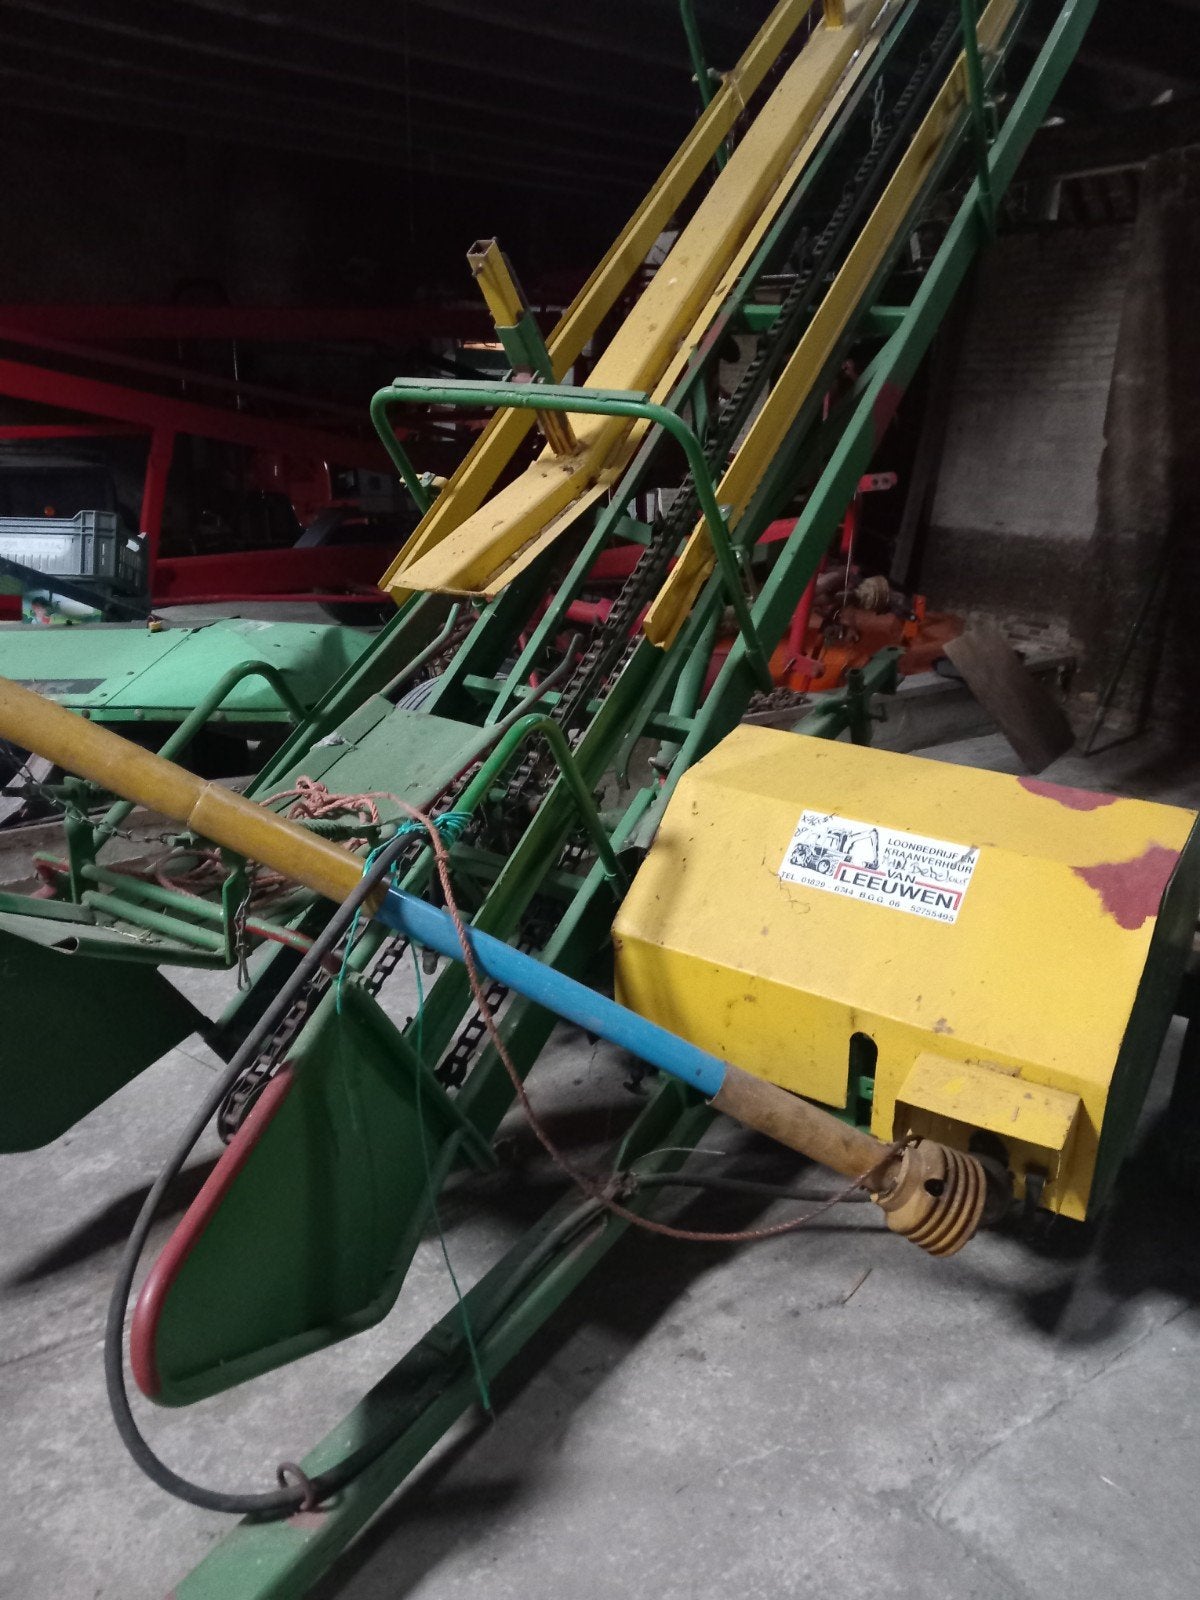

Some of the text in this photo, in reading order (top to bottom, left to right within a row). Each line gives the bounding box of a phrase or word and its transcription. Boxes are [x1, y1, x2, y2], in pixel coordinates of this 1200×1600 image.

[888, 838, 959, 859] LOONBEDRIJF
[887, 869, 916, 884] VAN
[839, 869, 953, 909] LEEUWEN
